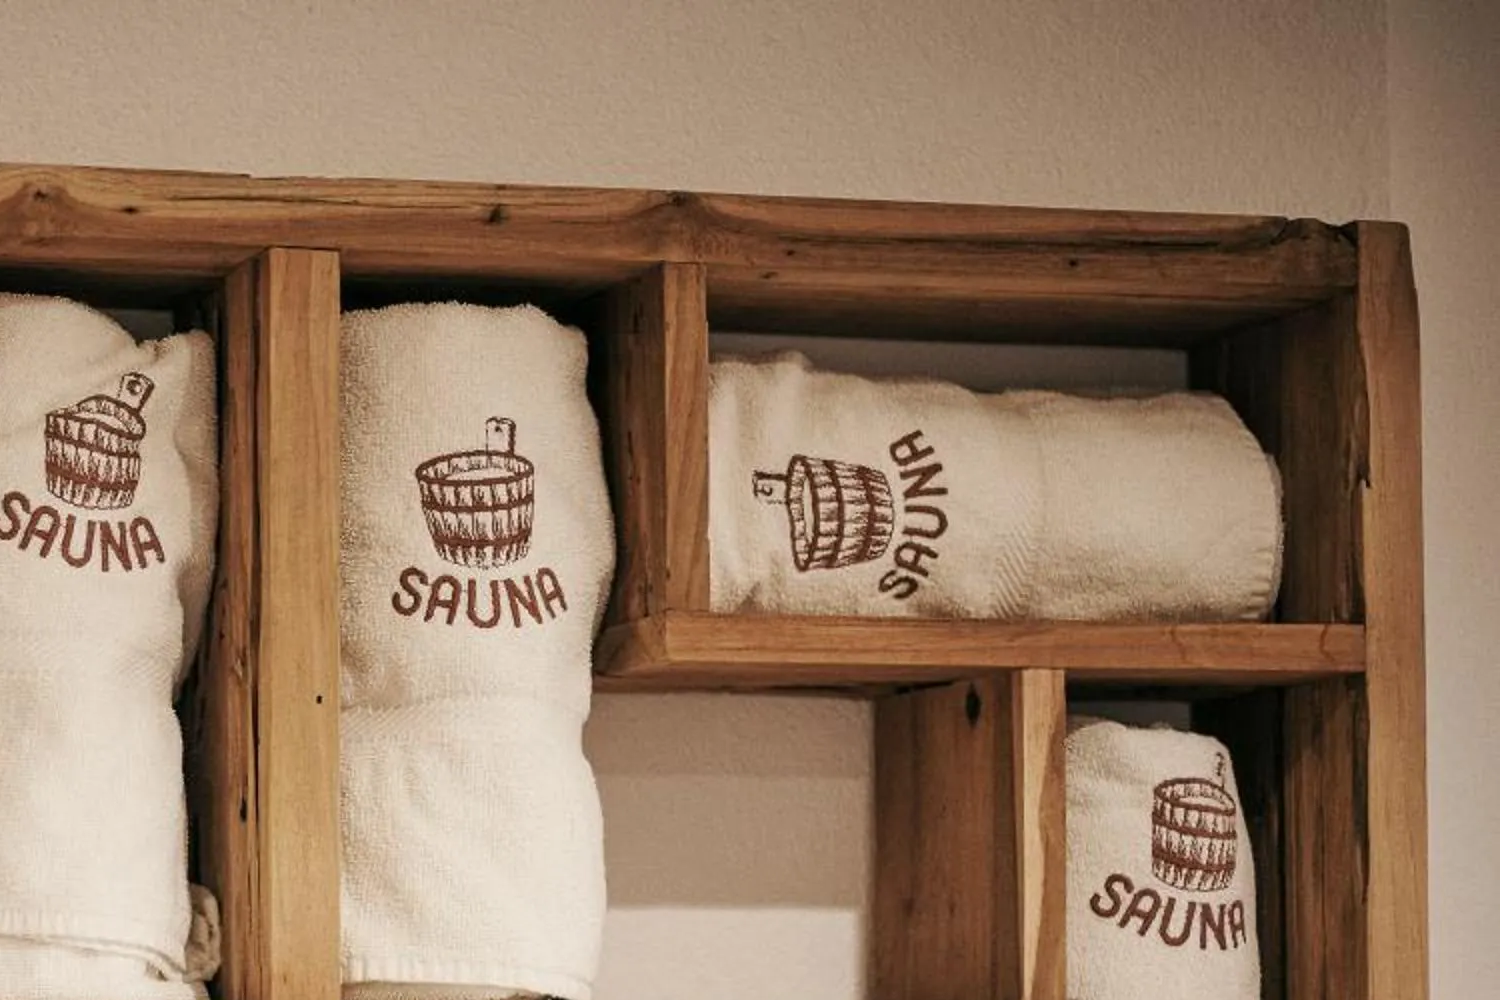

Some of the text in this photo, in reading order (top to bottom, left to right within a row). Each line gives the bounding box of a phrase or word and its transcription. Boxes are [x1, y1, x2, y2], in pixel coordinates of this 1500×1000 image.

[878, 430, 949, 600] SAUNA
[392, 566, 568, 629] SAUNA
[1089, 873, 1247, 951] SAUNA
